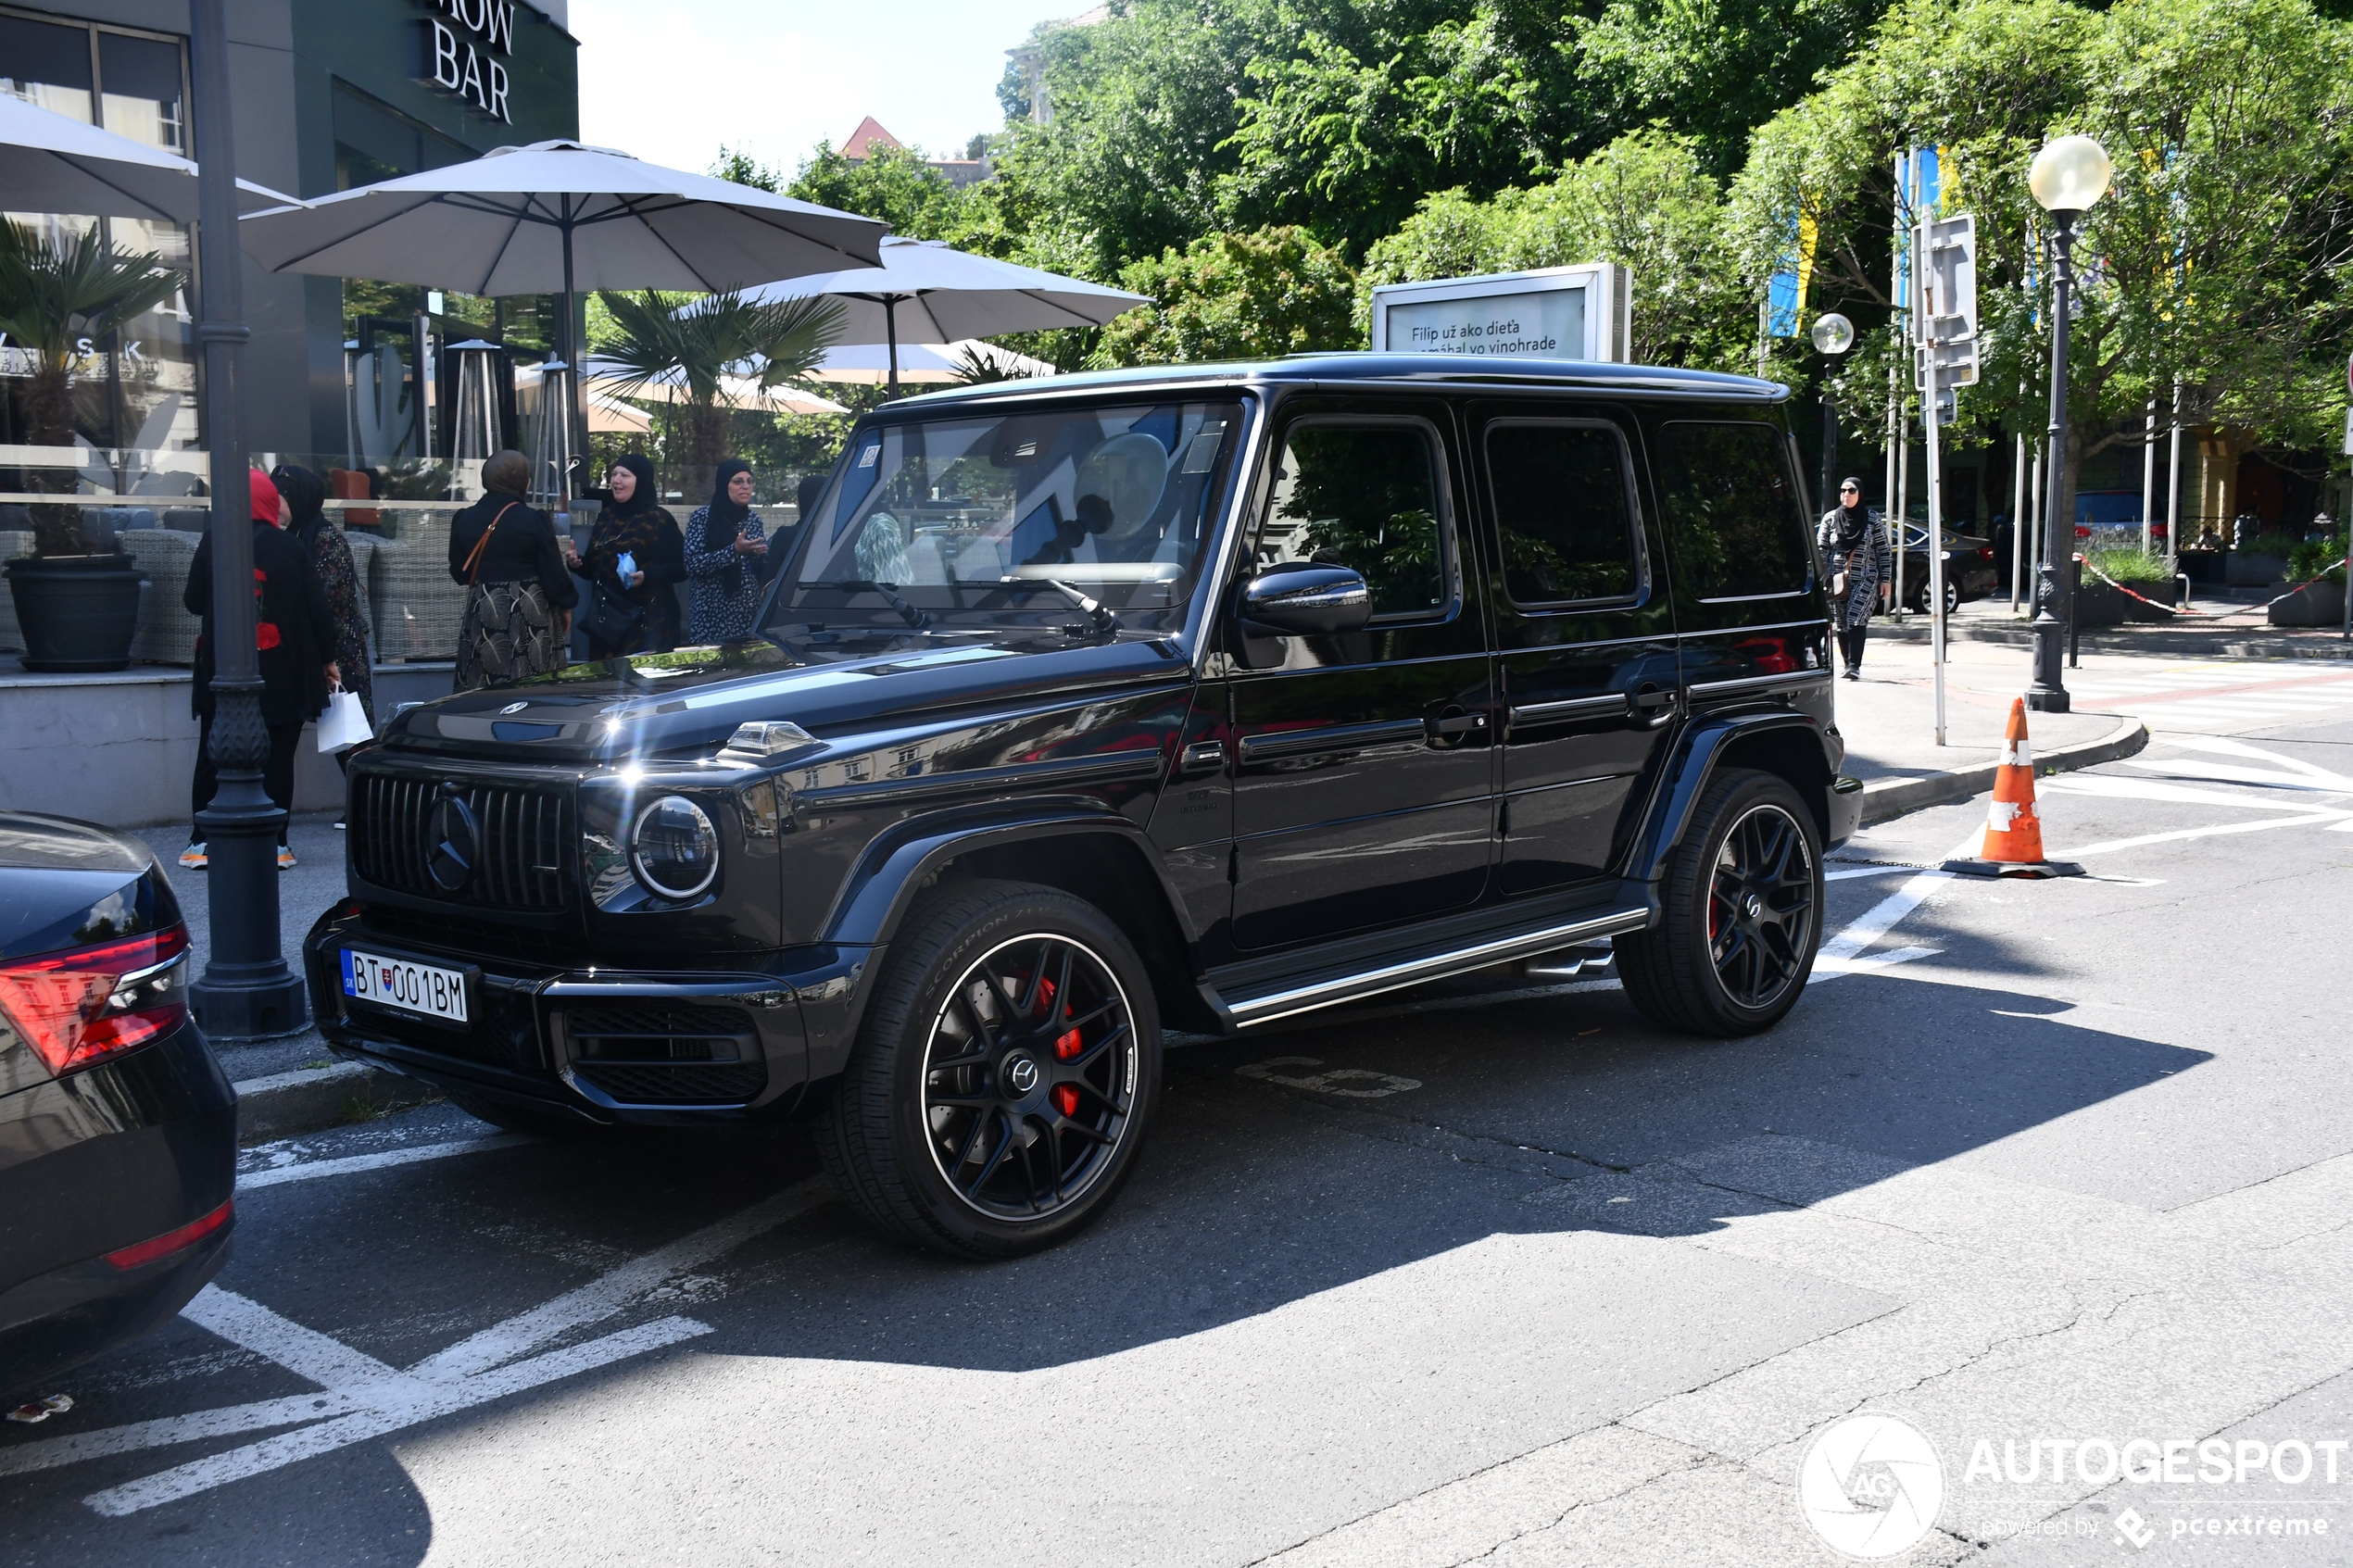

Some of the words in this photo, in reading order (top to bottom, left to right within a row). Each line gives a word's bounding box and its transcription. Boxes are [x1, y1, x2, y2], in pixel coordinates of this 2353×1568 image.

[438, 0, 515, 56] OW
[432, 19, 513, 126] BAR
[1412, 327, 1439, 344] Filip
[1442, 325, 1457, 339] už
[1460, 323, 1482, 337] ako
[1486, 320, 1519, 335] dieťa
[1469, 345, 1485, 355] vo
[1489, 336, 1556, 354] vinohrade
[925, 913, 1010, 999] SCORPION
[354, 956, 378, 997] BT
[392, 964, 463, 1016] 001BM
